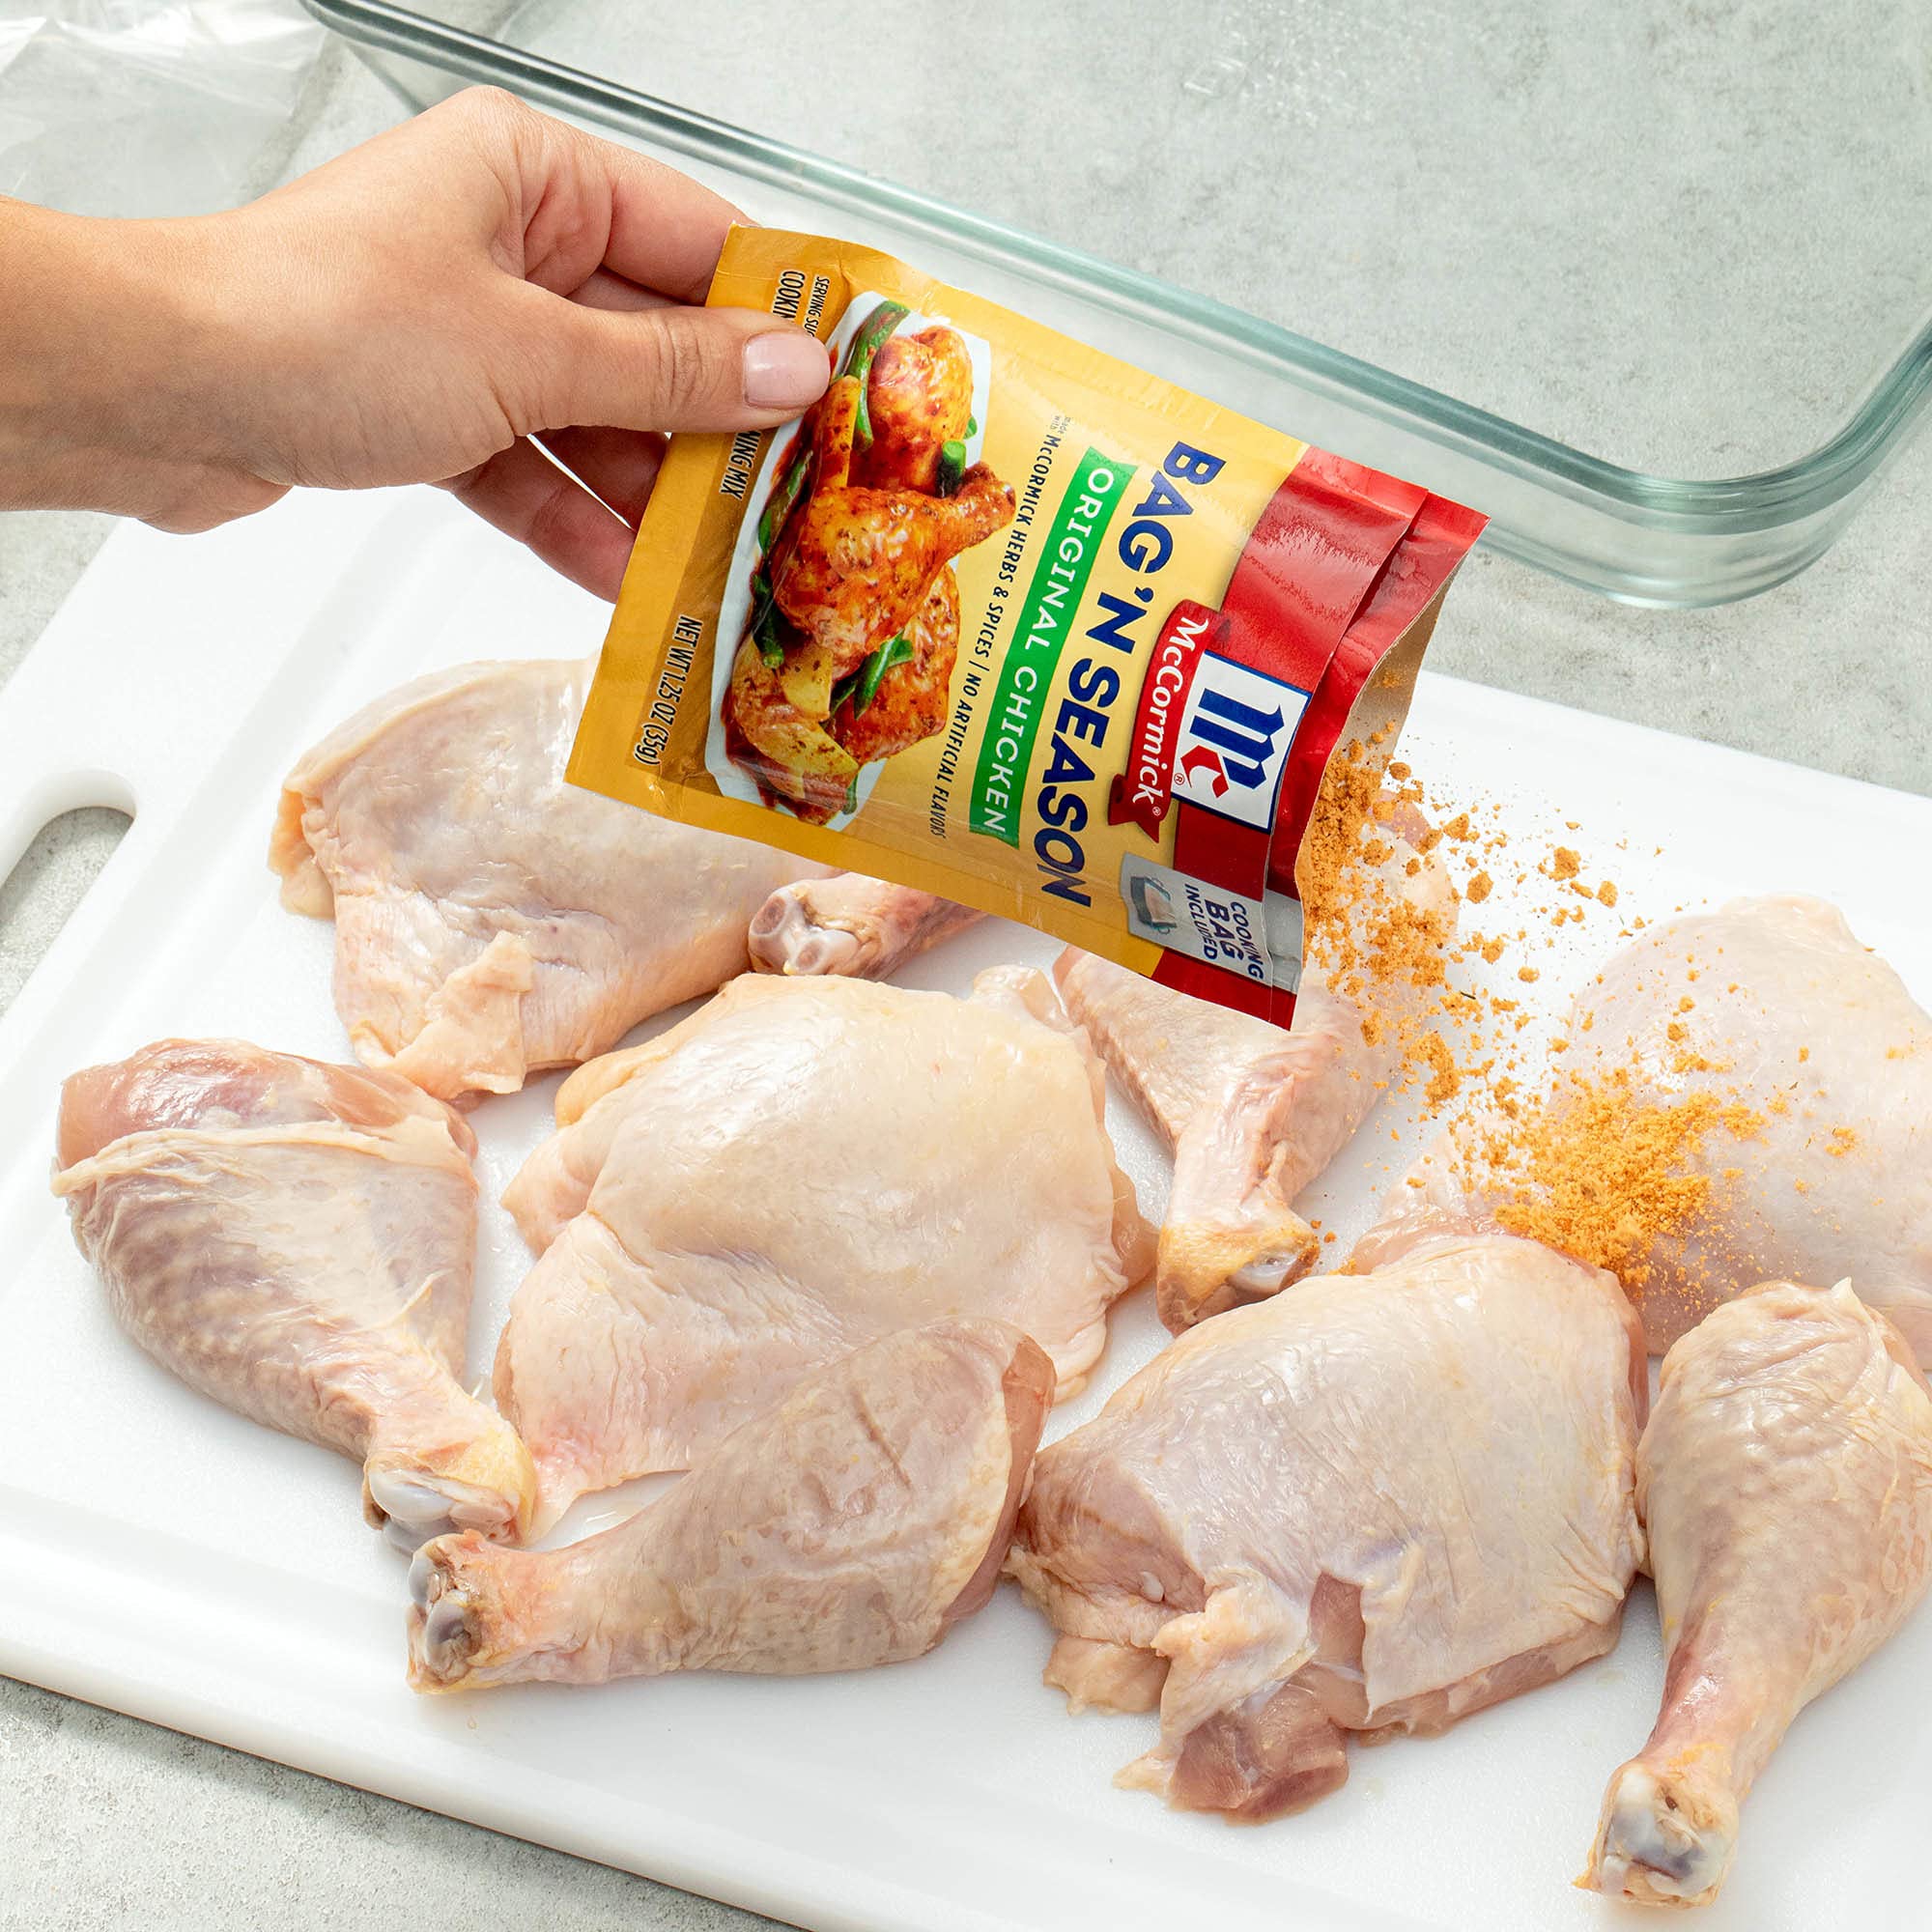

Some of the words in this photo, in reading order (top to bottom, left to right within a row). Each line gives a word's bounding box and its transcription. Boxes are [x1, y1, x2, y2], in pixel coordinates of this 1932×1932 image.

[773, 270, 806, 319] COOKIN
[808, 276, 830, 317] SERVING
[721, 467, 750, 499] MIX
[1118, 440, 1227, 574] BAG
[998, 529, 1028, 582] HERBS
[1025, 468, 1114, 650] ORIGINAL
[993, 586, 1009, 599] &
[674, 615, 703, 647] NET
[975, 603, 1004, 658] SPICES
[667, 647, 695, 672] WT
[962, 672, 982, 696] NO
[650, 702, 676, 724] OZ
[658, 671, 687, 703] 1.25
[635, 724, 669, 765] (35g)
[936, 698, 974, 783] ARTIFICIAL
[983, 666, 1037, 833] CHICKEN
[1034, 658, 1121, 908] SEASON
[929, 785, 950, 839] FLAVORS
[1184, 883, 1218, 960] INCLUDED
[1204, 899, 1244, 960] BAG
[1230, 901, 1264, 980] COOKING
